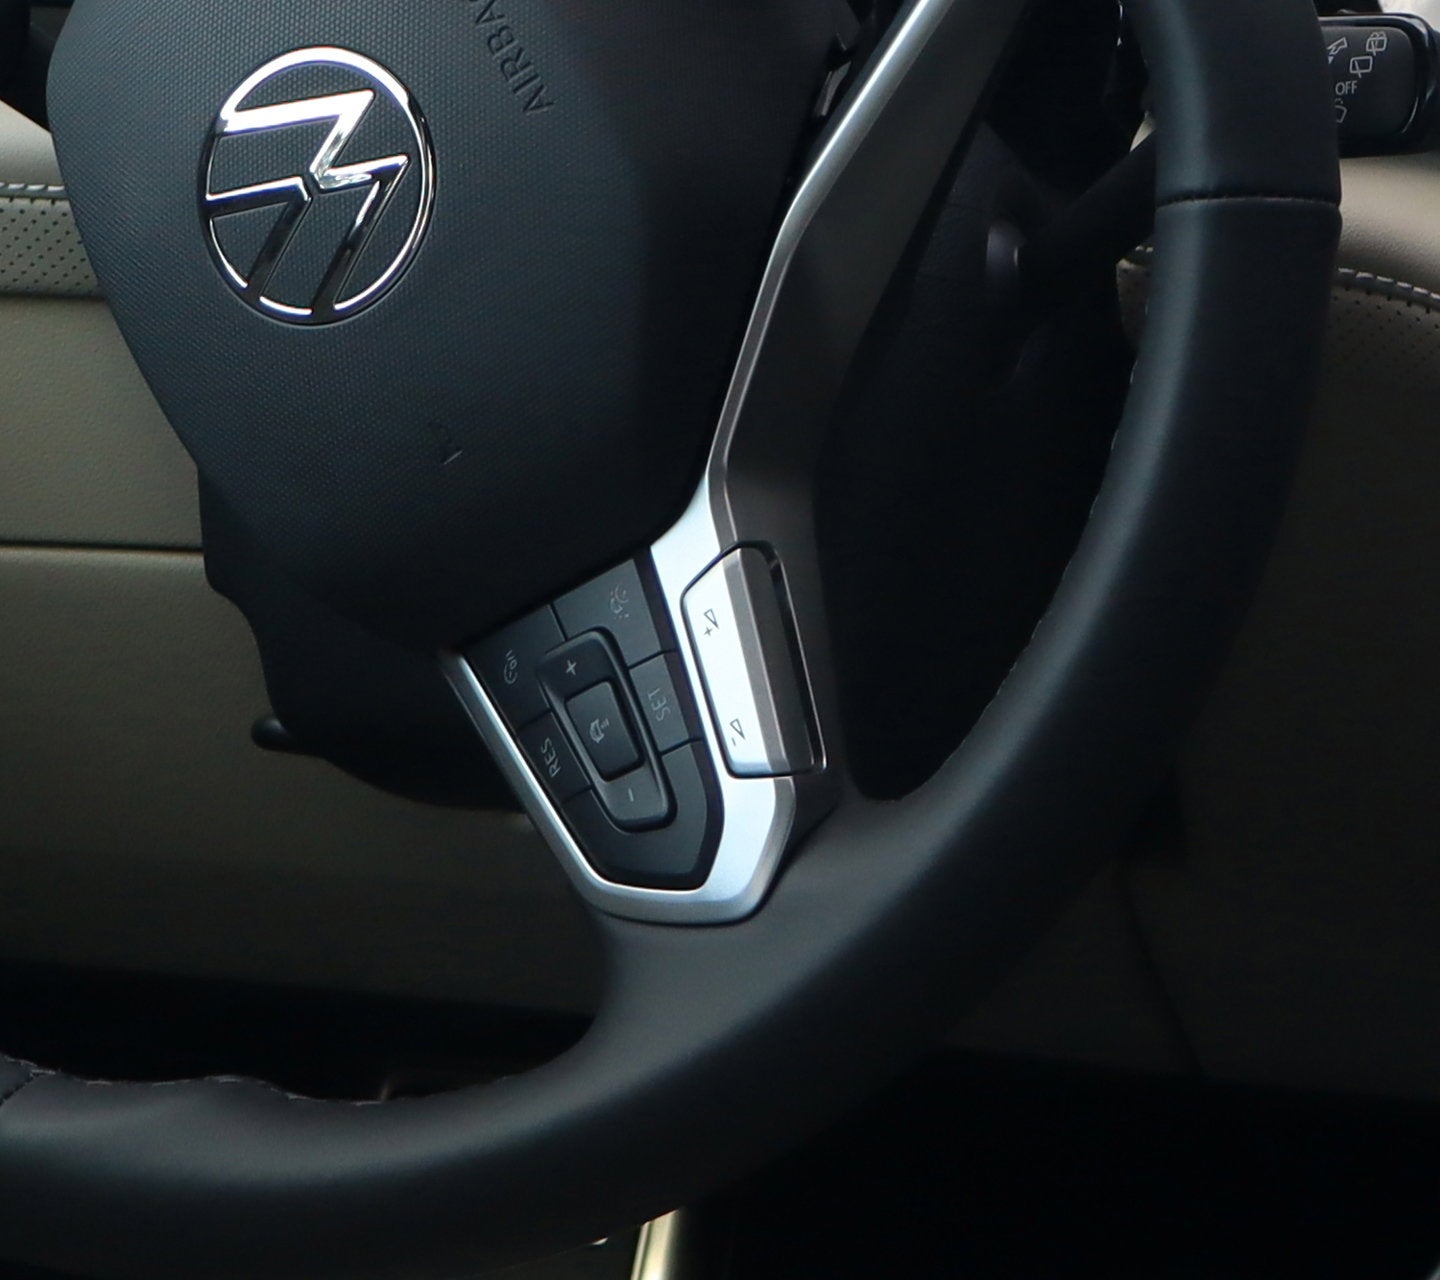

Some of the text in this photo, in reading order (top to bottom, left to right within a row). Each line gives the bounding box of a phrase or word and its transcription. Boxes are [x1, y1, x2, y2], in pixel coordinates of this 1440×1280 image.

[1334, 80, 1358, 96] OFF
[646, 689, 672, 723] SET
[540, 737, 561, 778] RES
